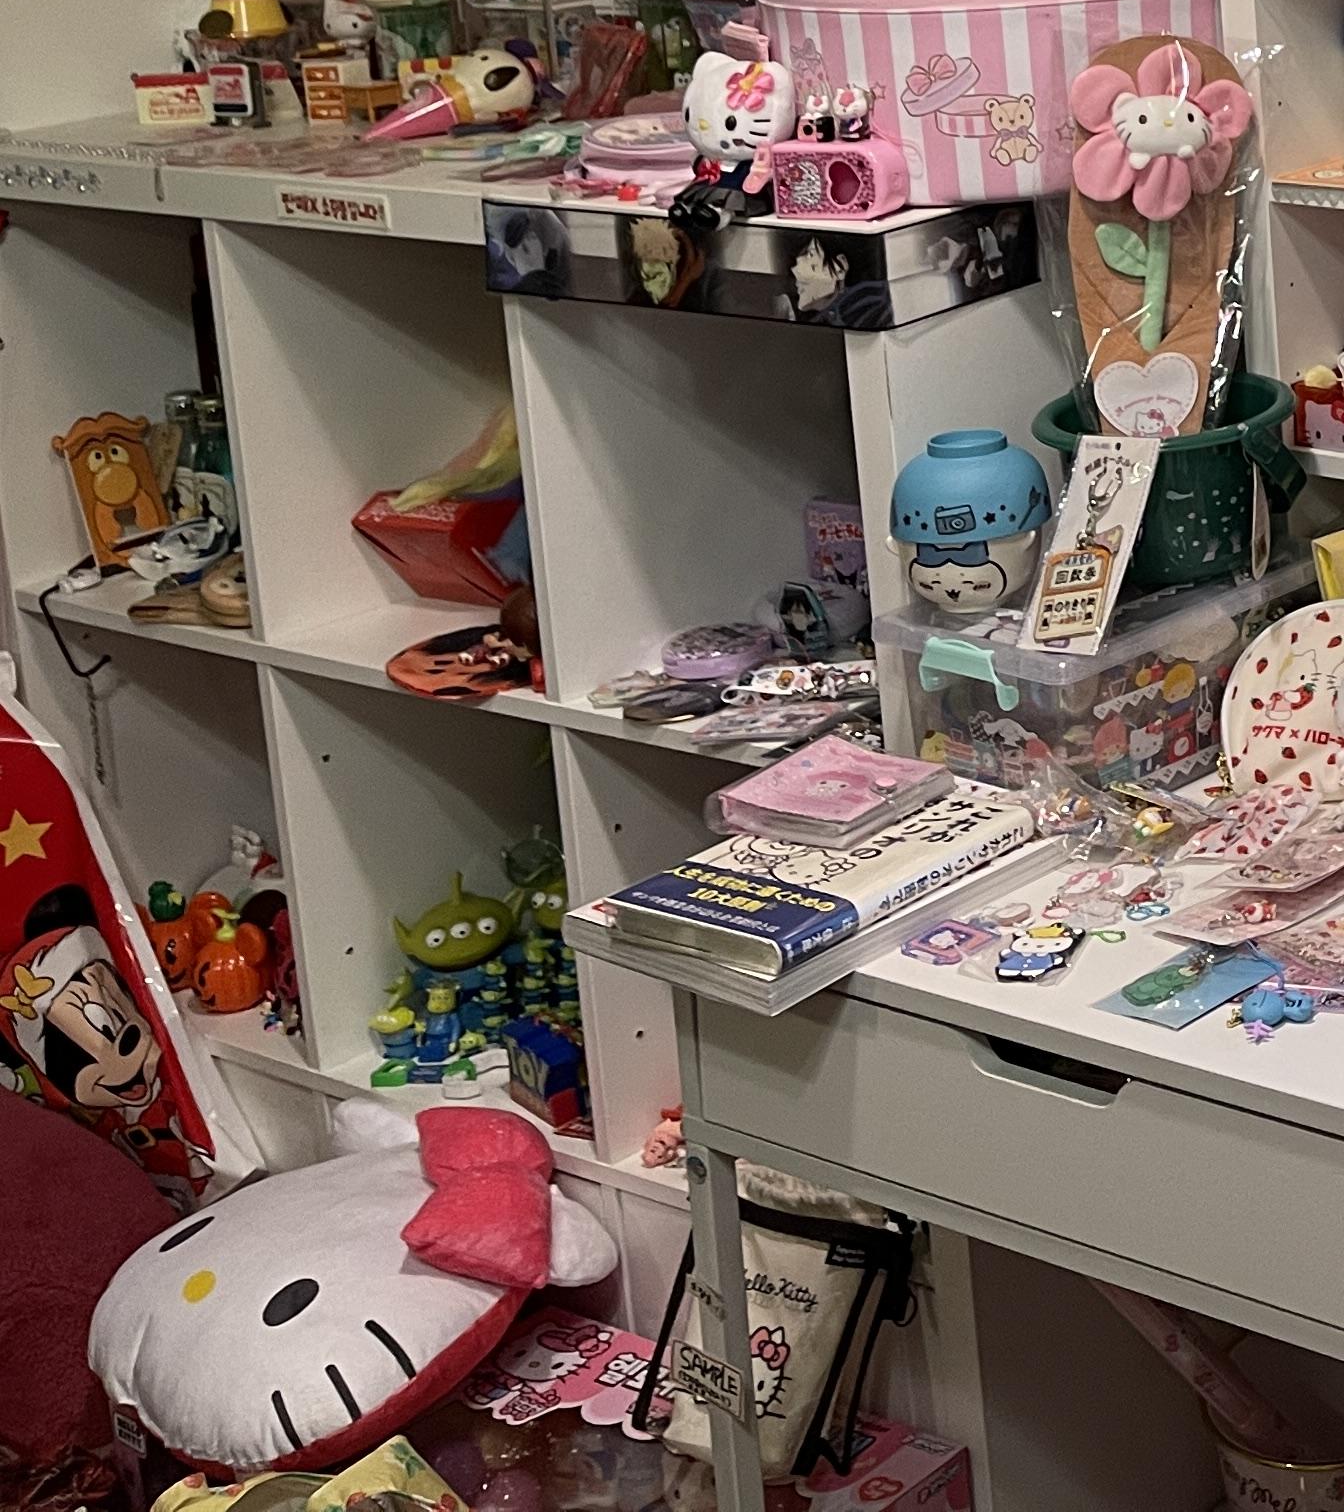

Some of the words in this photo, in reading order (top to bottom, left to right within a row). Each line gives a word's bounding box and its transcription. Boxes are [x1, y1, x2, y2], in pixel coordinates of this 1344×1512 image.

[1252, 725, 1287, 739] サクマ
[744, 1273, 776, 1295] ello
[775, 1277, 819, 1313] Kitty
[679, 1345, 738, 1396] SAMPLE
